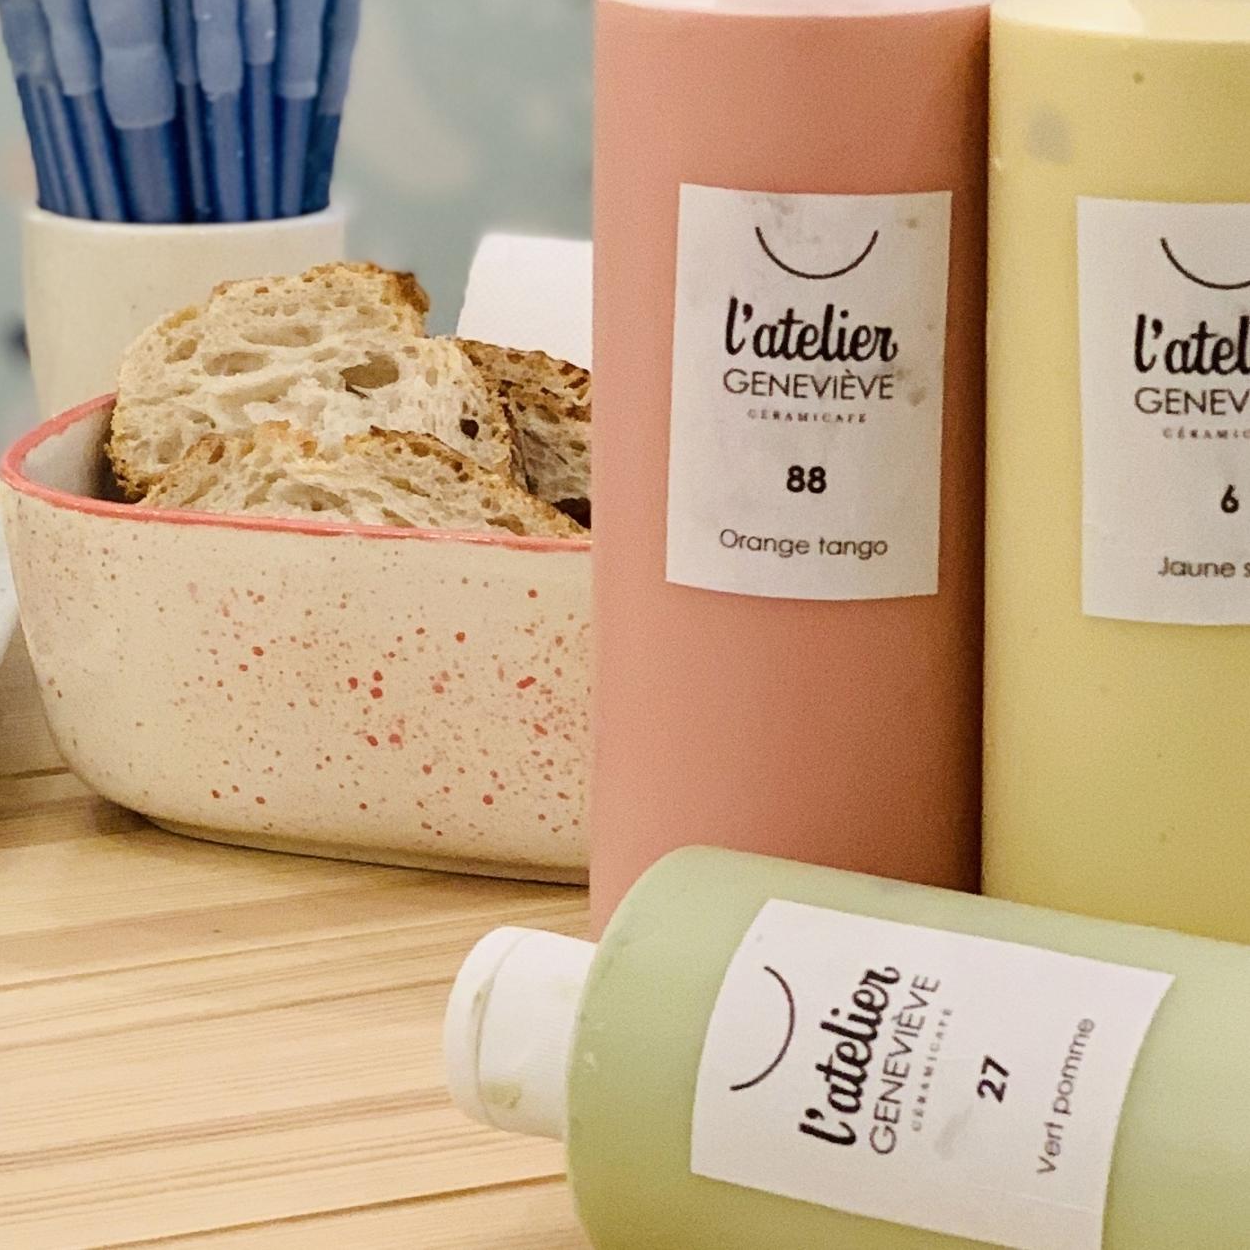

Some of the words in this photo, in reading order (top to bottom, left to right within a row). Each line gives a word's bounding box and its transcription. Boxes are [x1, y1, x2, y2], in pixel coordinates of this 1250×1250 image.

[724, 295, 898, 363] l'atelier
[722, 367, 894, 401] GENEVIÈVE
[786, 464, 828, 495] 88
[1220, 483, 1240, 514] 6
[719, 528, 810, 559] Orange
[818, 535, 888, 561] tango
[1157, 556, 1237, 578] Jaune
[798, 965, 901, 1146] l'atelier
[869, 974, 941, 1155] GENEVIÈVE
[976, 1055, 1010, 1104] 27
[1036, 1121, 1065, 1175] Vert
[1052, 1018, 1096, 1116] pomme
